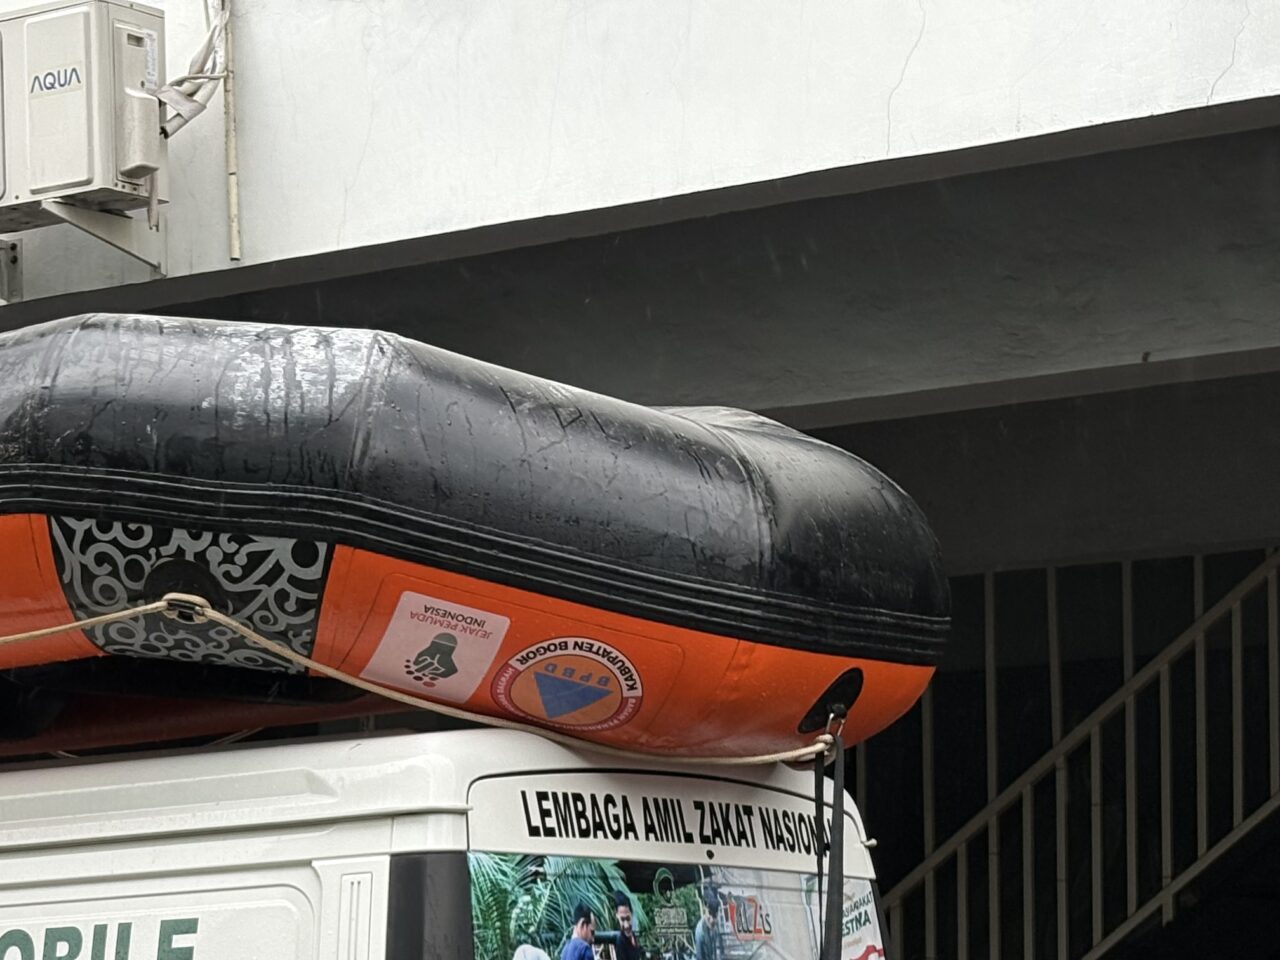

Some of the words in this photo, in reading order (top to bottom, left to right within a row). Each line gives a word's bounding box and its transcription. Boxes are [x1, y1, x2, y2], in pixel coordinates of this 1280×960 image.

[30, 66, 82, 96] AQUA
[409, 611, 459, 632] PEMUDA
[423, 604, 486, 628] INDONESIA
[459, 622, 494, 640] JEJAK
[515, 641, 569, 666] BOGOR
[572, 640, 639, 691] KABUPATEN
[521, 790, 639, 841] LEMBAGA
[645, 798, 694, 844] AMIL
[694, 801, 756, 849] ZAKAT
[759, 806, 832, 858] NASIONA
